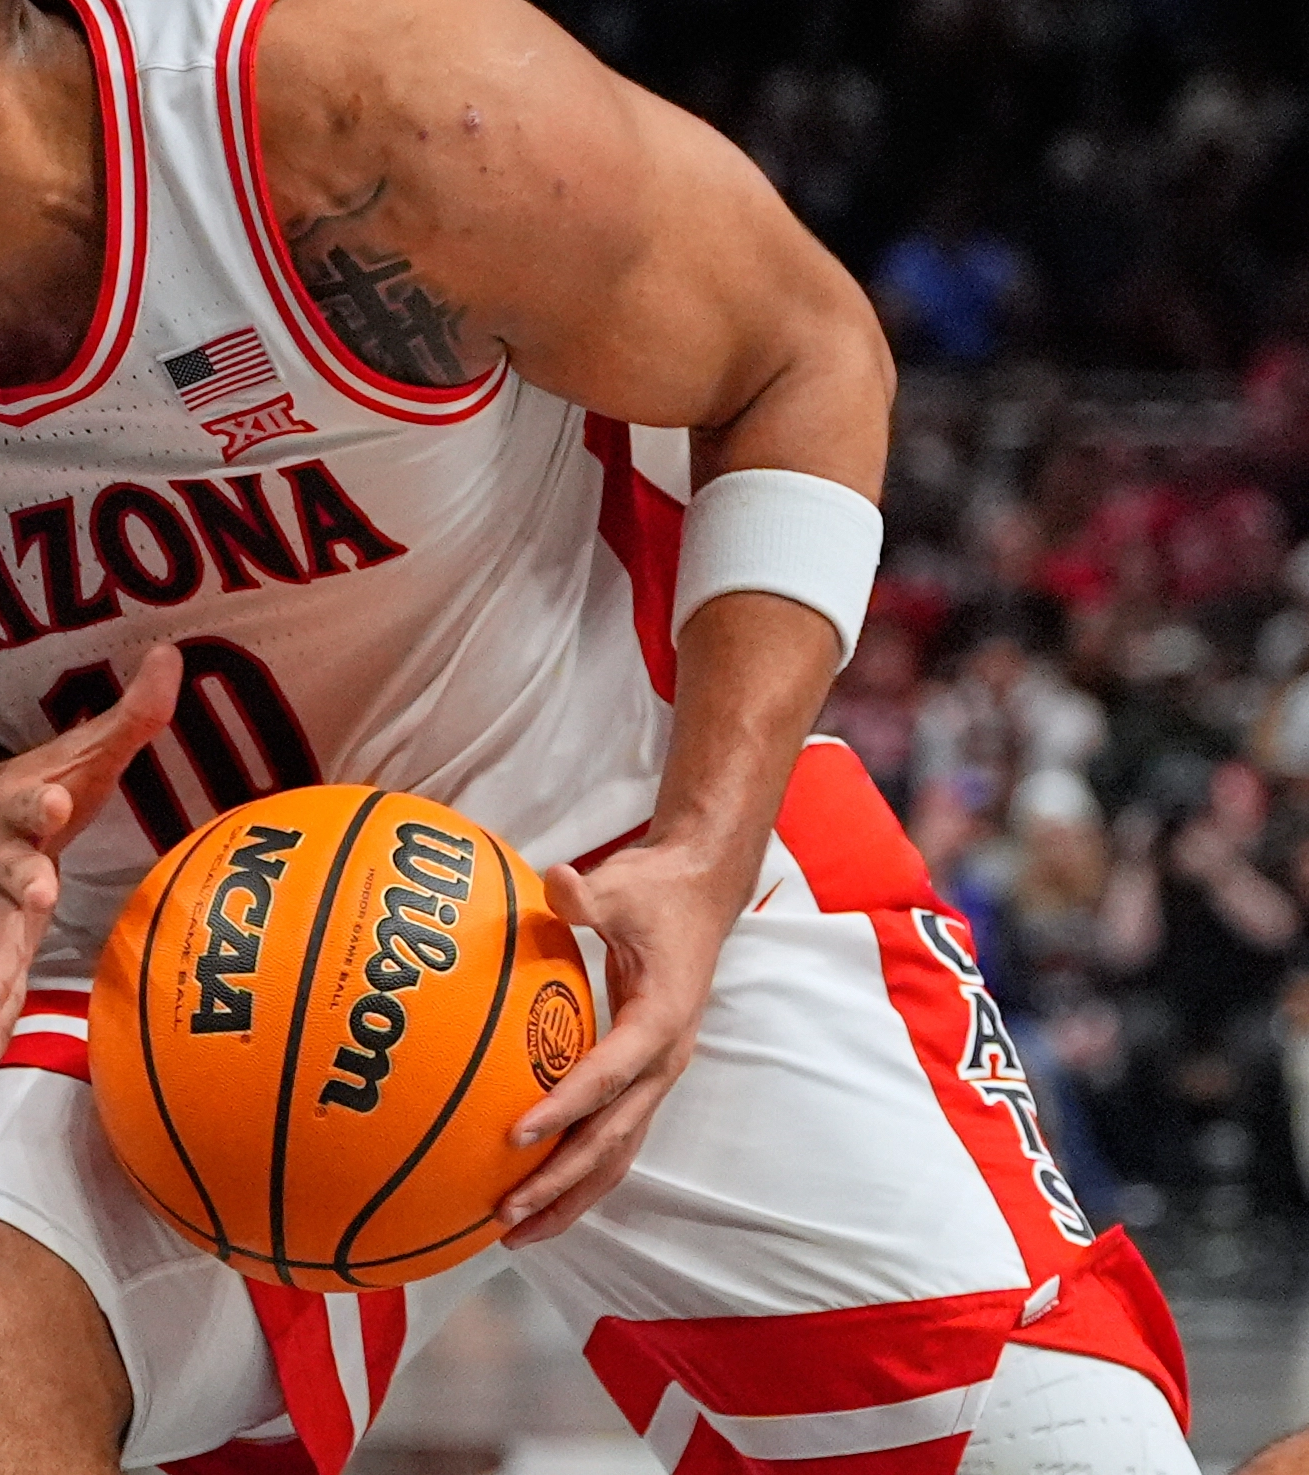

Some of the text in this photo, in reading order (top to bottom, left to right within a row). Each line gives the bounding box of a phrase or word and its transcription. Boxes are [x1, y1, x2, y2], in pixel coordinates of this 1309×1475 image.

[173, 971, 187, 1033] BALL
[189, 825, 303, 1035] NCAA
[319, 821, 477, 1115] Wilson
[329, 971, 349, 1010] BALL
[911, 908, 1096, 1246] CATS
